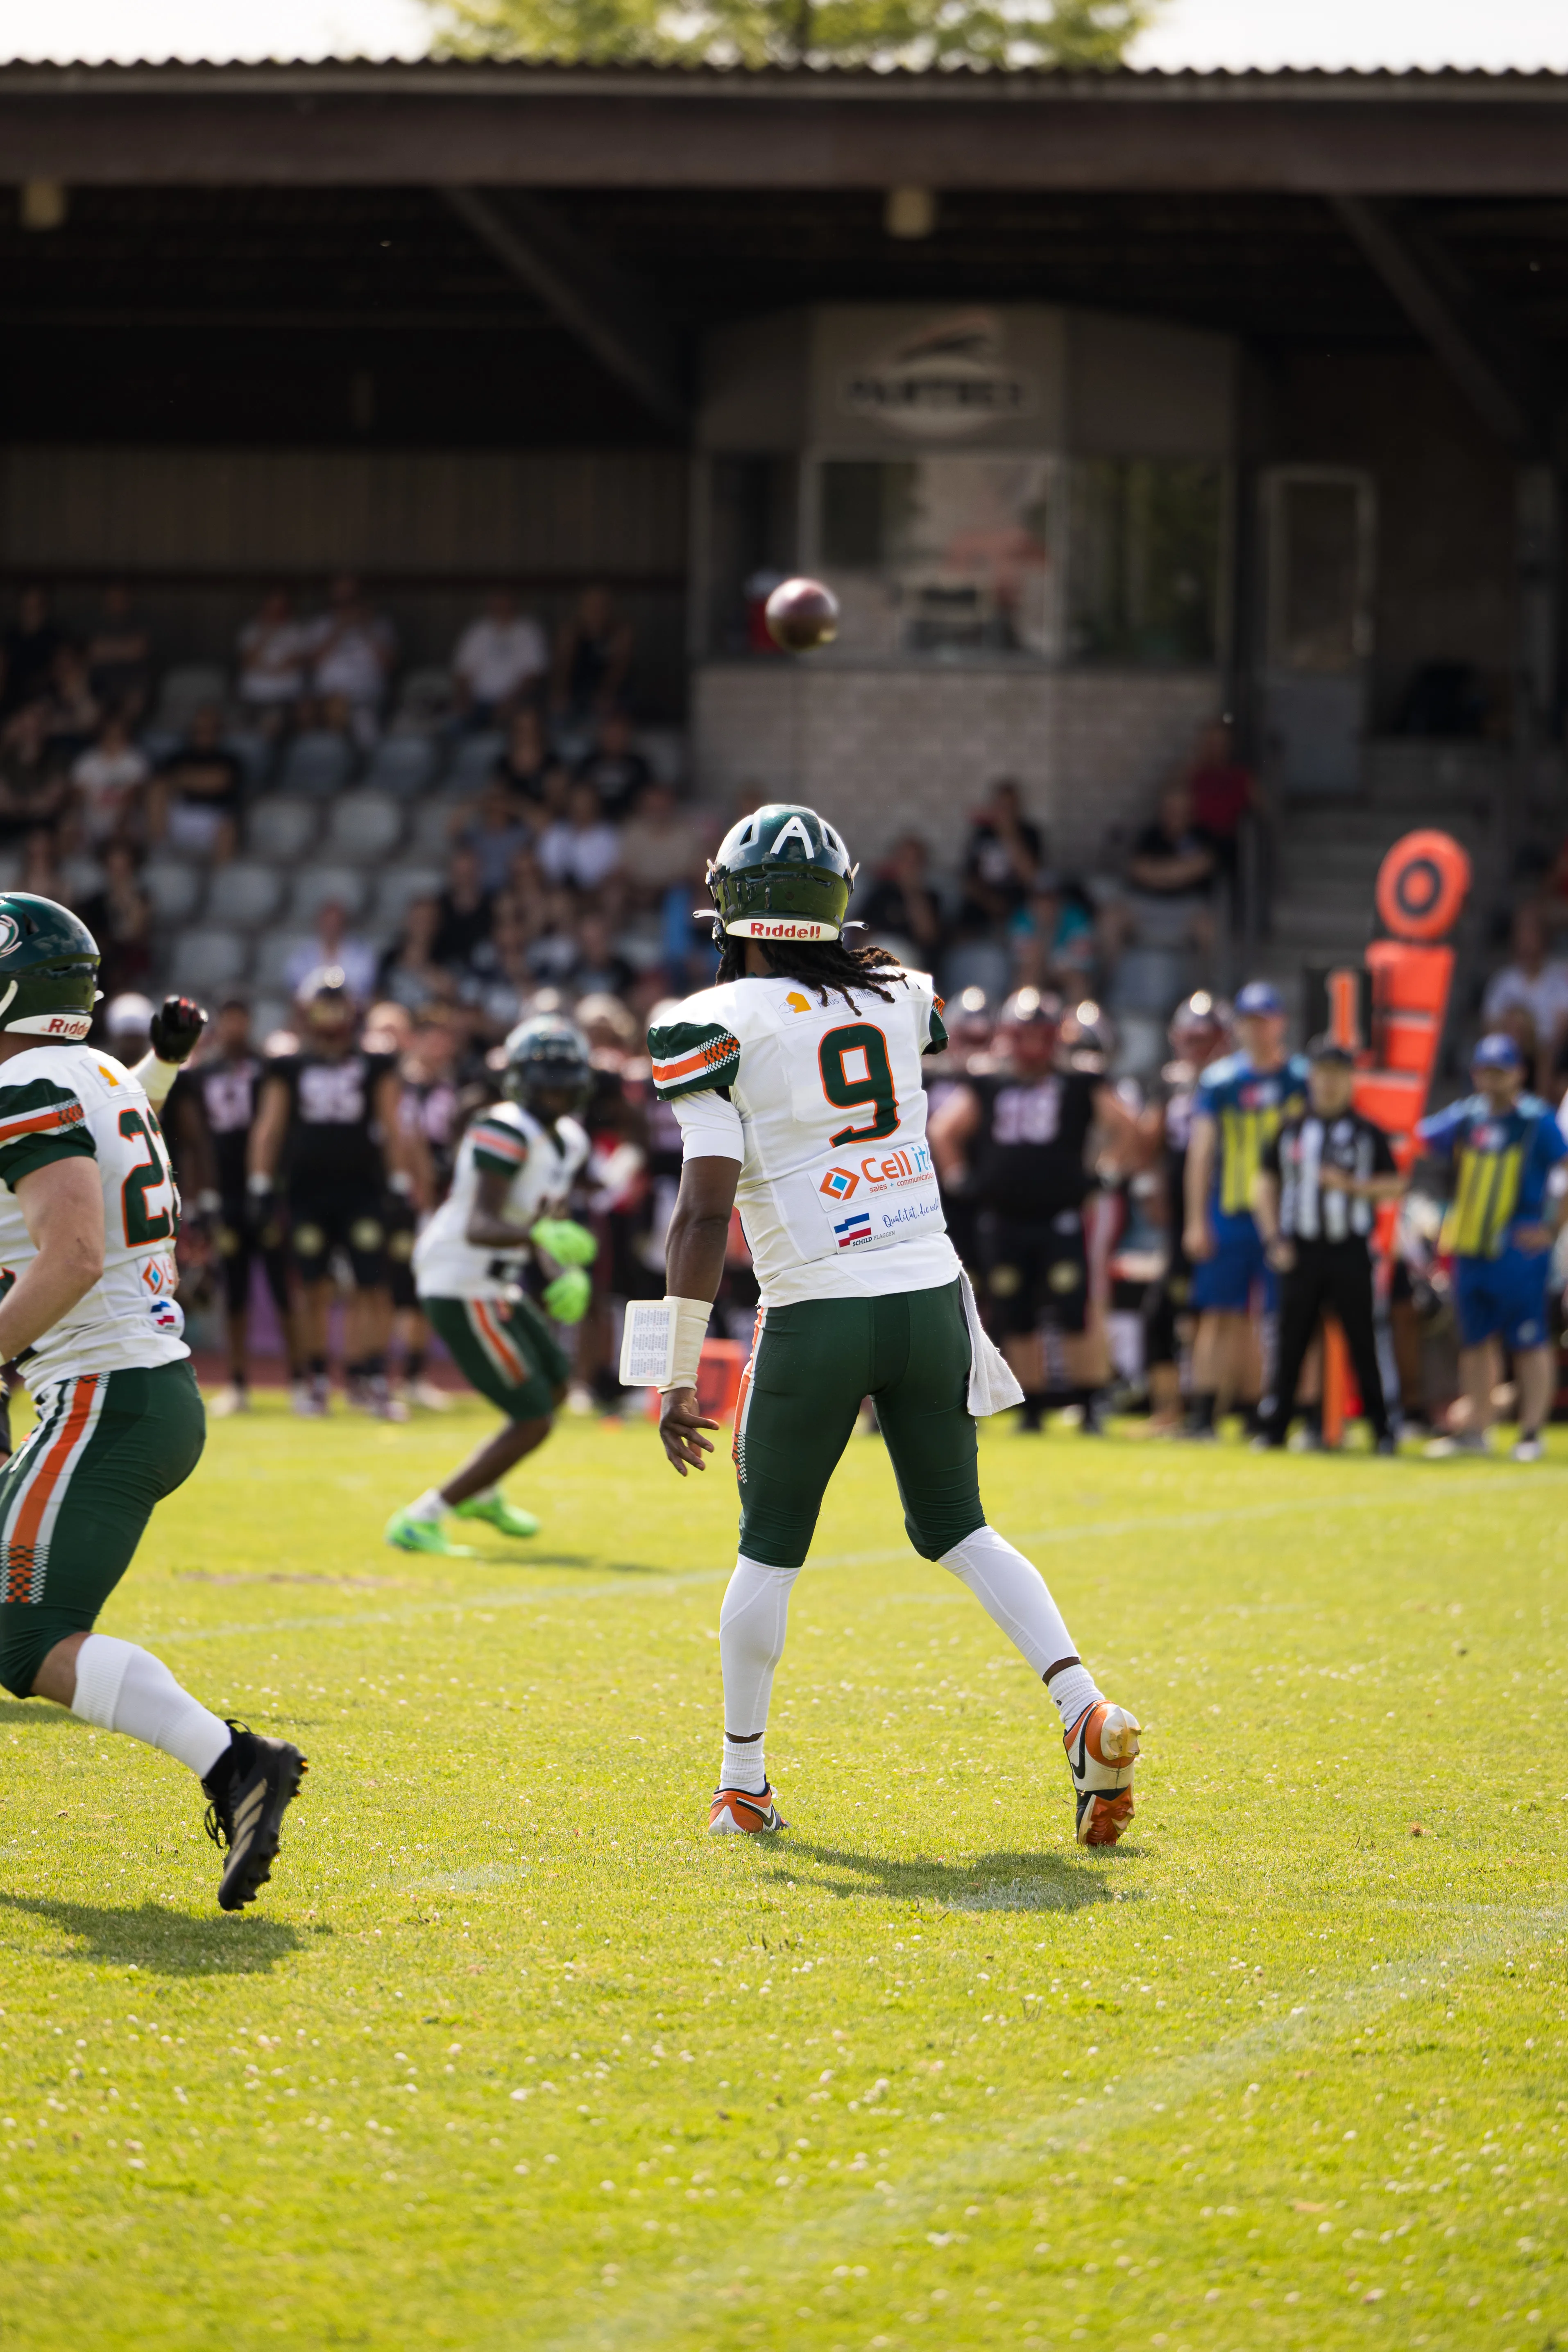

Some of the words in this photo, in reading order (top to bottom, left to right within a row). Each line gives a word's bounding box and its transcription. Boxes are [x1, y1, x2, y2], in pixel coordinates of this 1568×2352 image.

[770, 816, 814, 859] A
[750, 922, 820, 939] Riddell
[840, 995, 852, 1003] dr
[854, 989, 873, 1000] Hilfe
[818, 1022, 901, 1148] 9
[861, 1150, 913, 1183] Cell
[869, 1183, 888, 1193] sales
[920, 1203, 929, 1216] die
[852, 1237, 872, 1247] SCHILD
[873, 1230, 895, 1241] FLAGGEN
